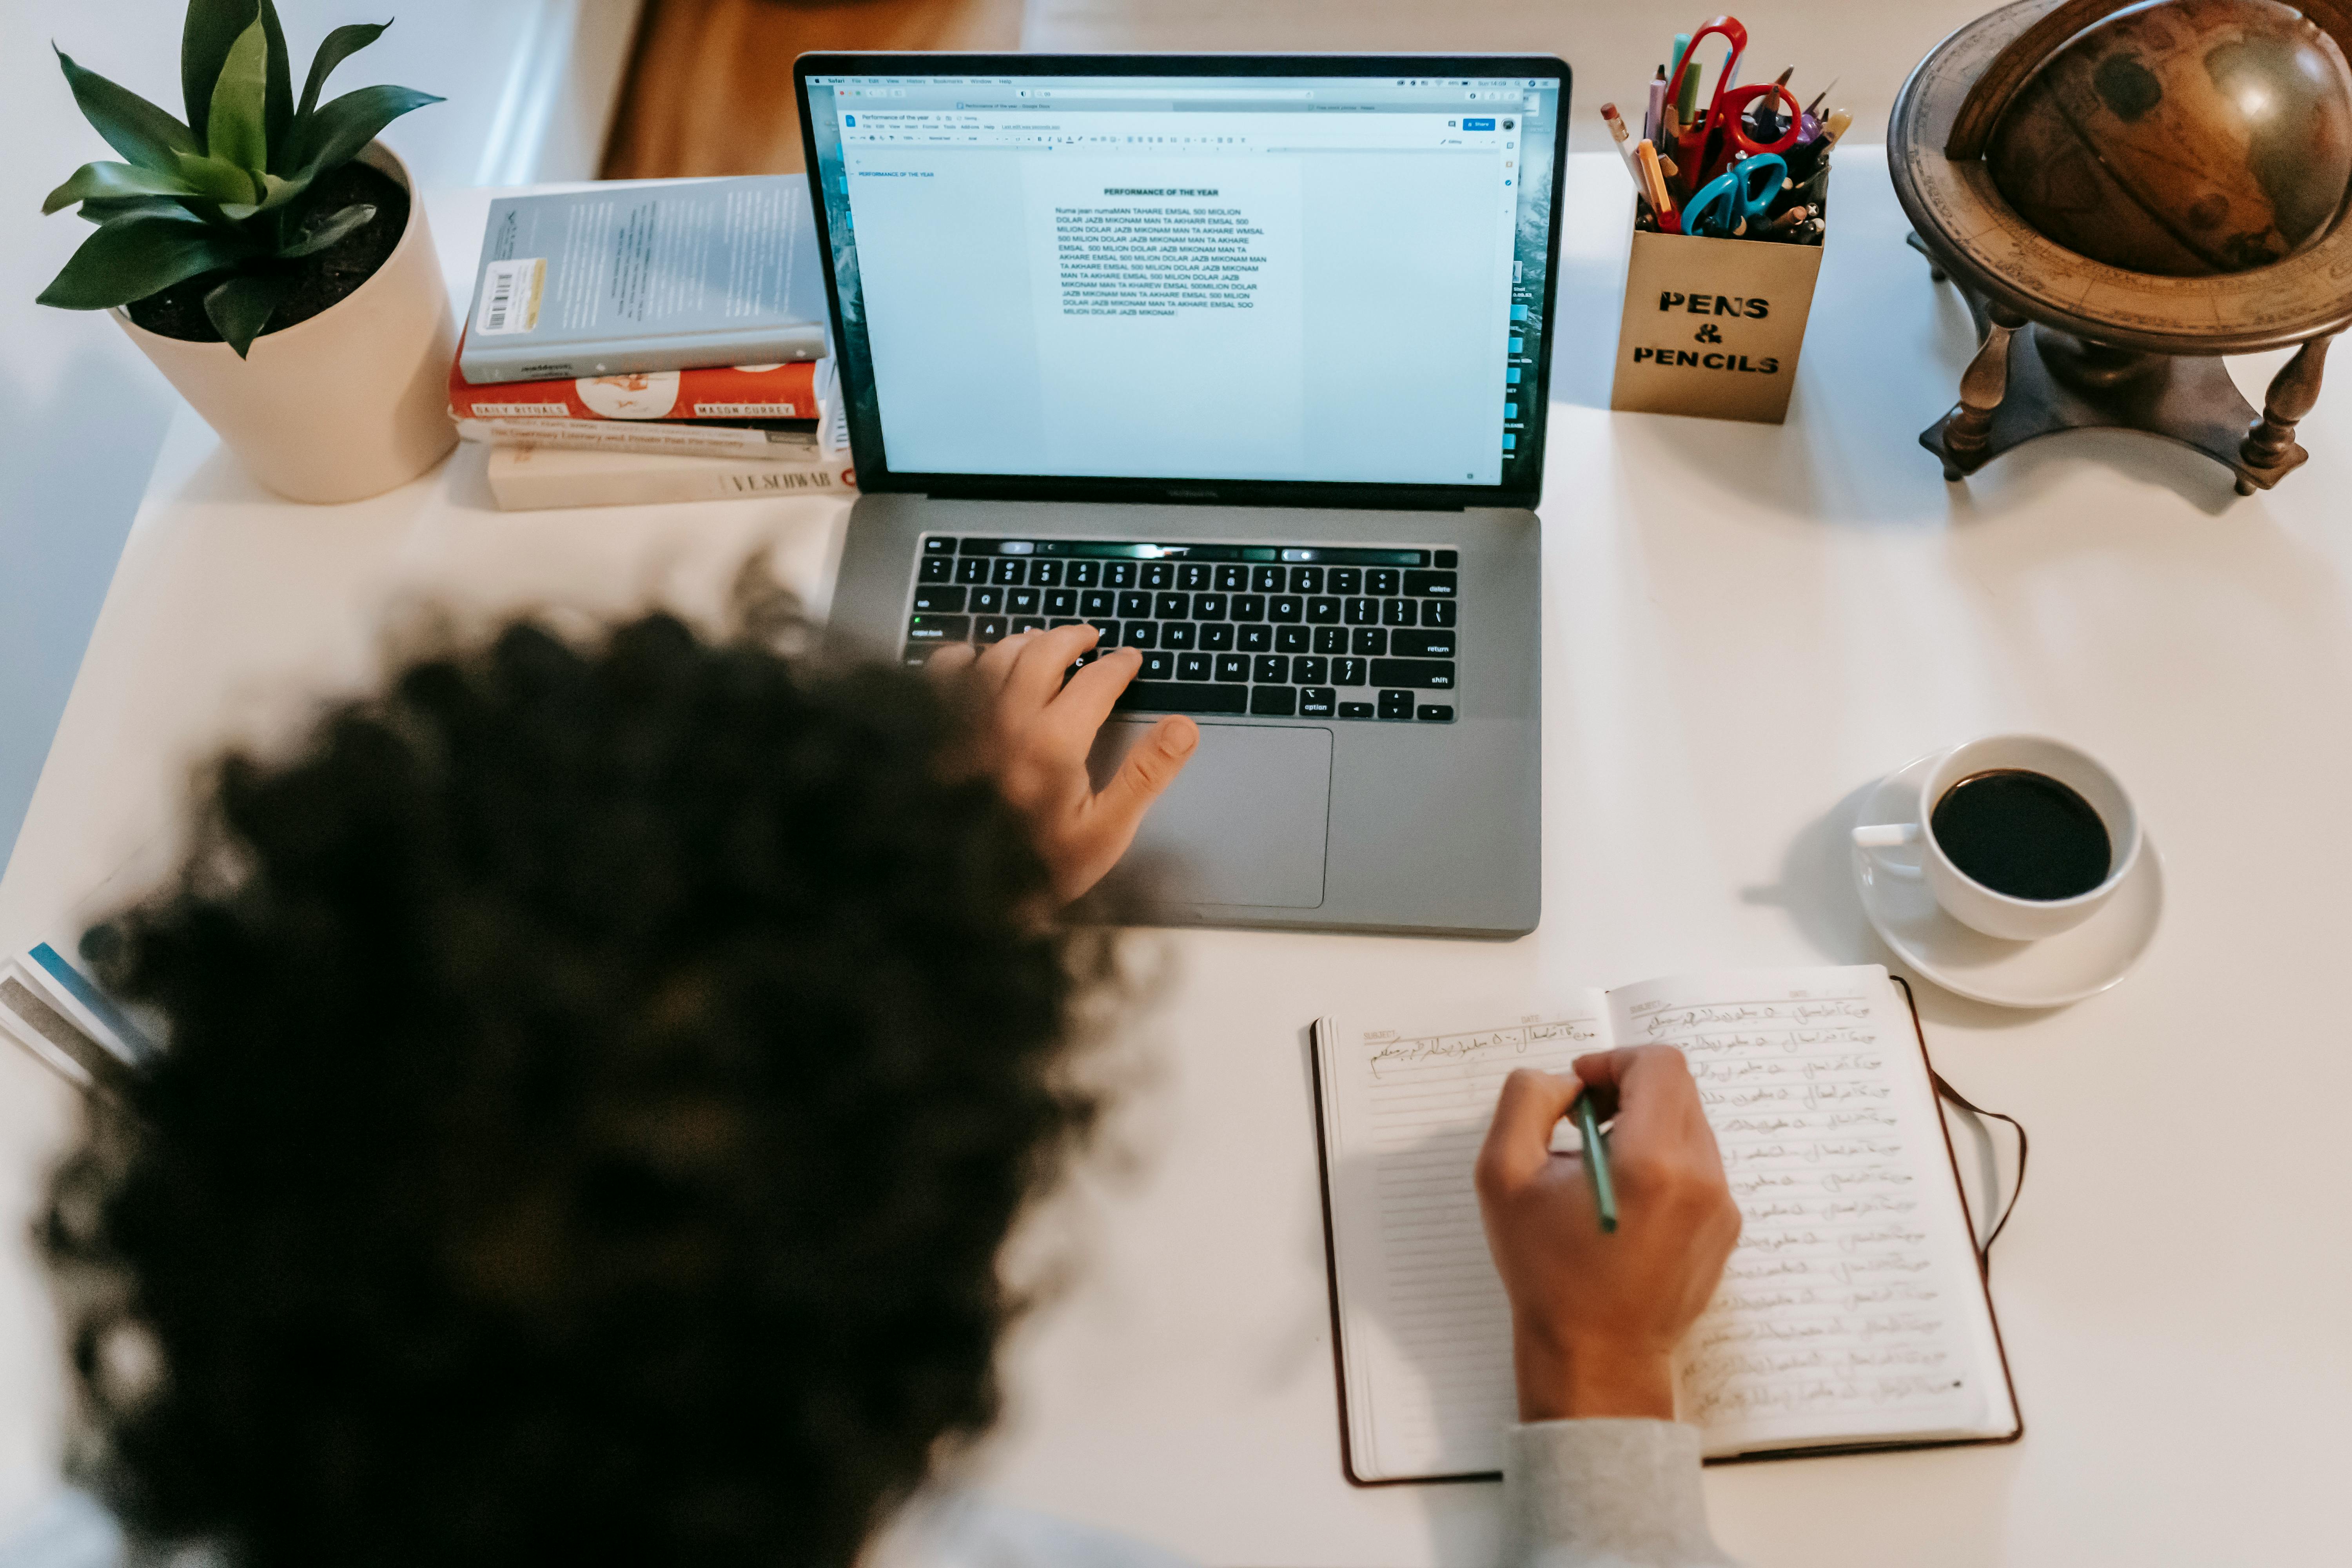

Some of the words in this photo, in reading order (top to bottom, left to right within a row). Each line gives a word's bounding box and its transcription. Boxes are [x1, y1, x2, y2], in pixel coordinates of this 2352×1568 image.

[1659, 292, 1769, 319] PENS
[1695, 323, 1722, 344] &
[1633, 347, 1779, 374] PENCILS
[475, 406, 508, 414] DAILY
[514, 406, 564, 414] RITUALS
[698, 405, 740, 414] MASON
[745, 406, 790, 414] CURREY
[762, 472, 831, 488] SCHWAB
[1018, 596, 1029, 605] W
[1131, 599, 1138, 608] T
[1169, 601, 1176, 609] Y
[1205, 602, 1214, 611] U
[1281, 604, 1290, 613] O
[1319, 605, 1327, 614] P
[1174, 631, 1183, 639] H
[1213, 632, 1220, 641] J
[1250, 633, 1258, 642] K
[1289, 634, 1296, 643] L
[1076, 657, 1083, 667] C
[1190, 661, 1199, 670] N
[1228, 662, 1238, 671] M
